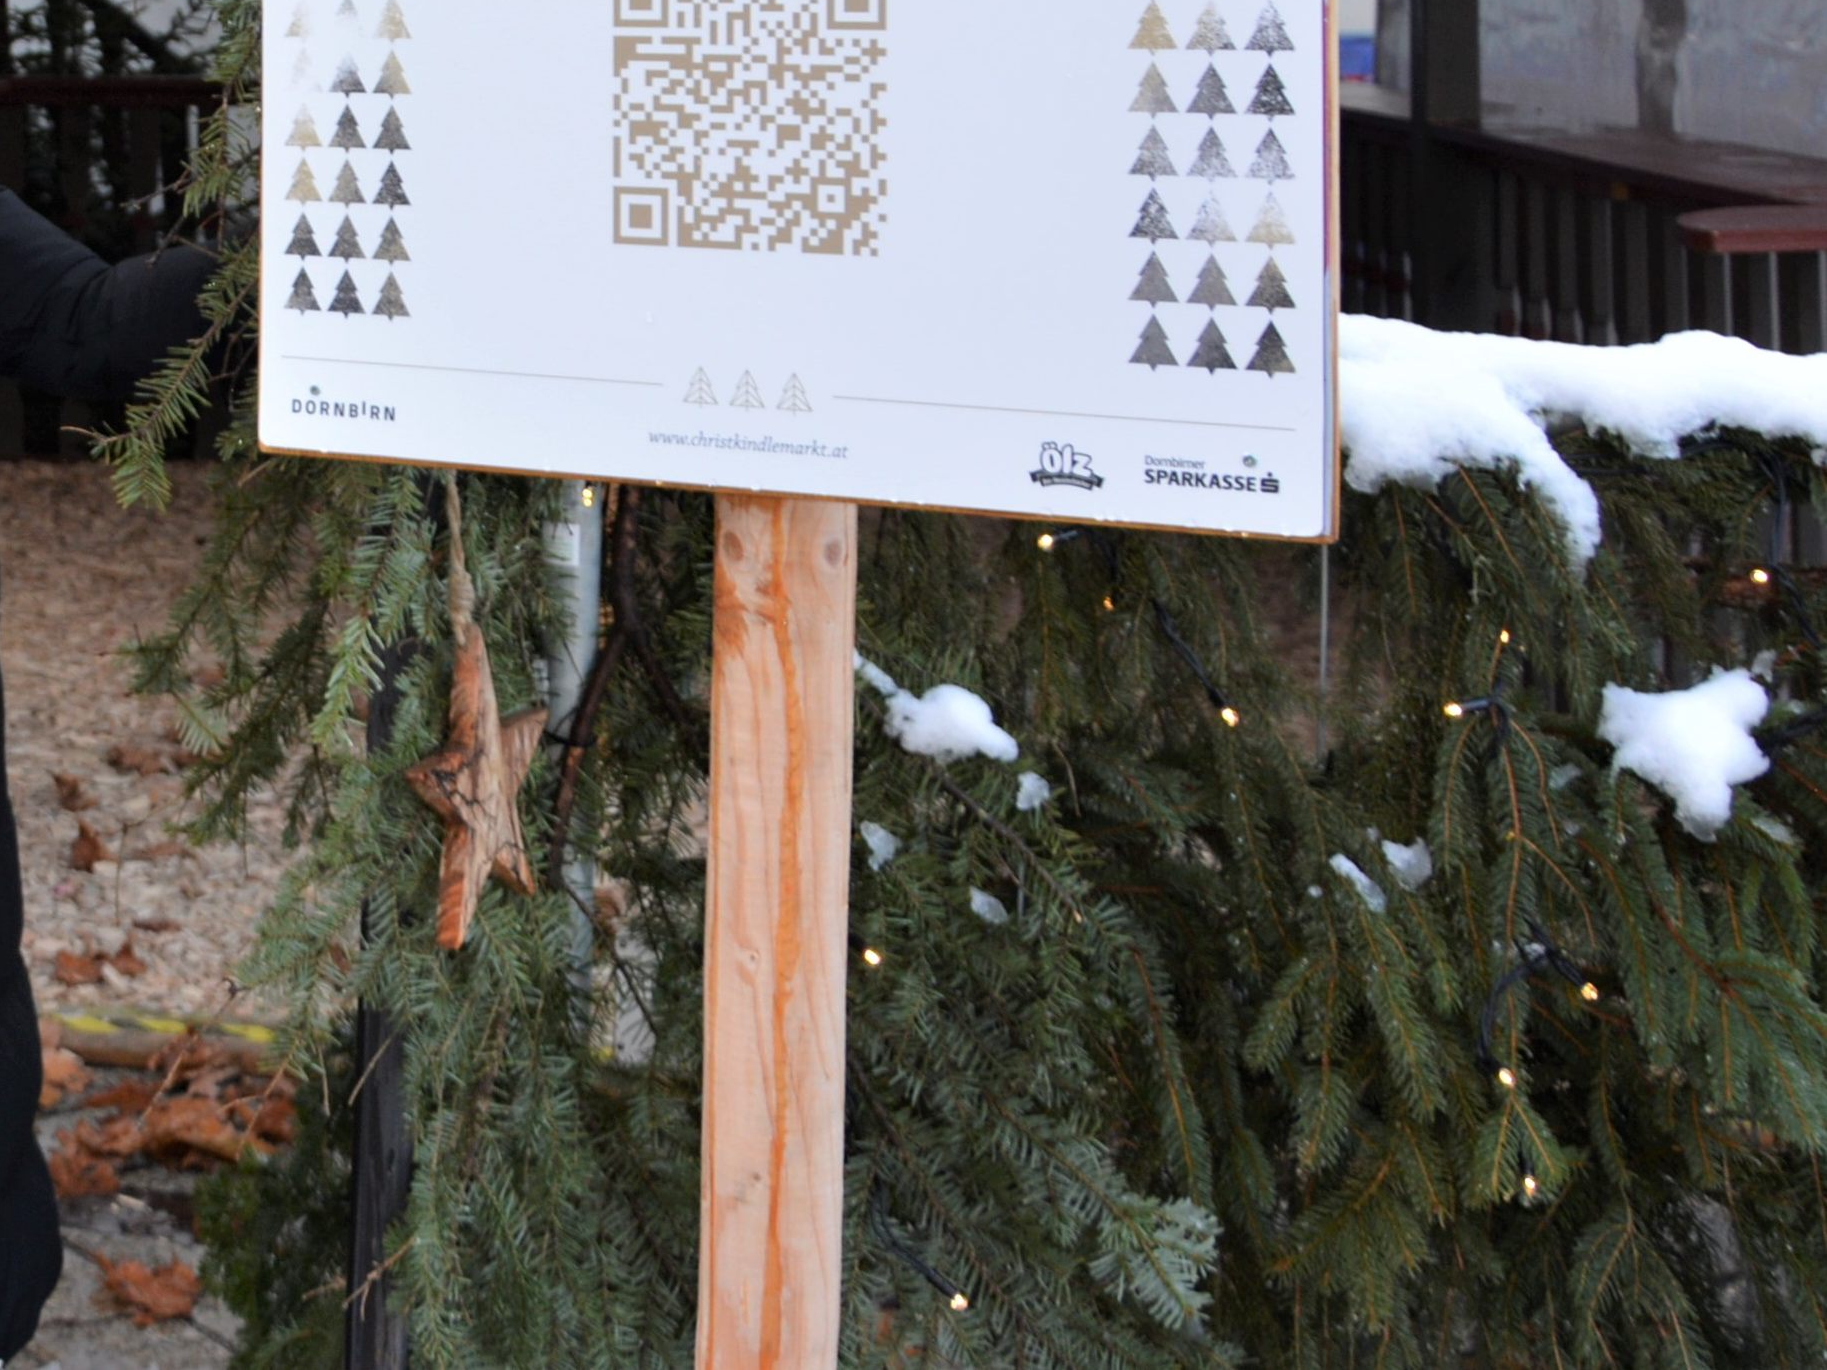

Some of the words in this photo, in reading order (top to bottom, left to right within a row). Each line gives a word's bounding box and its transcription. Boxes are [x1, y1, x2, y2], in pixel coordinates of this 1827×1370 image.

[290, 397, 396, 422] DORNBIRN
[648, 430, 849, 459] www.christkindlemarkt.at
[1039, 441, 1093, 477] Ölz
[1143, 467, 1258, 493] SPARKASSE
